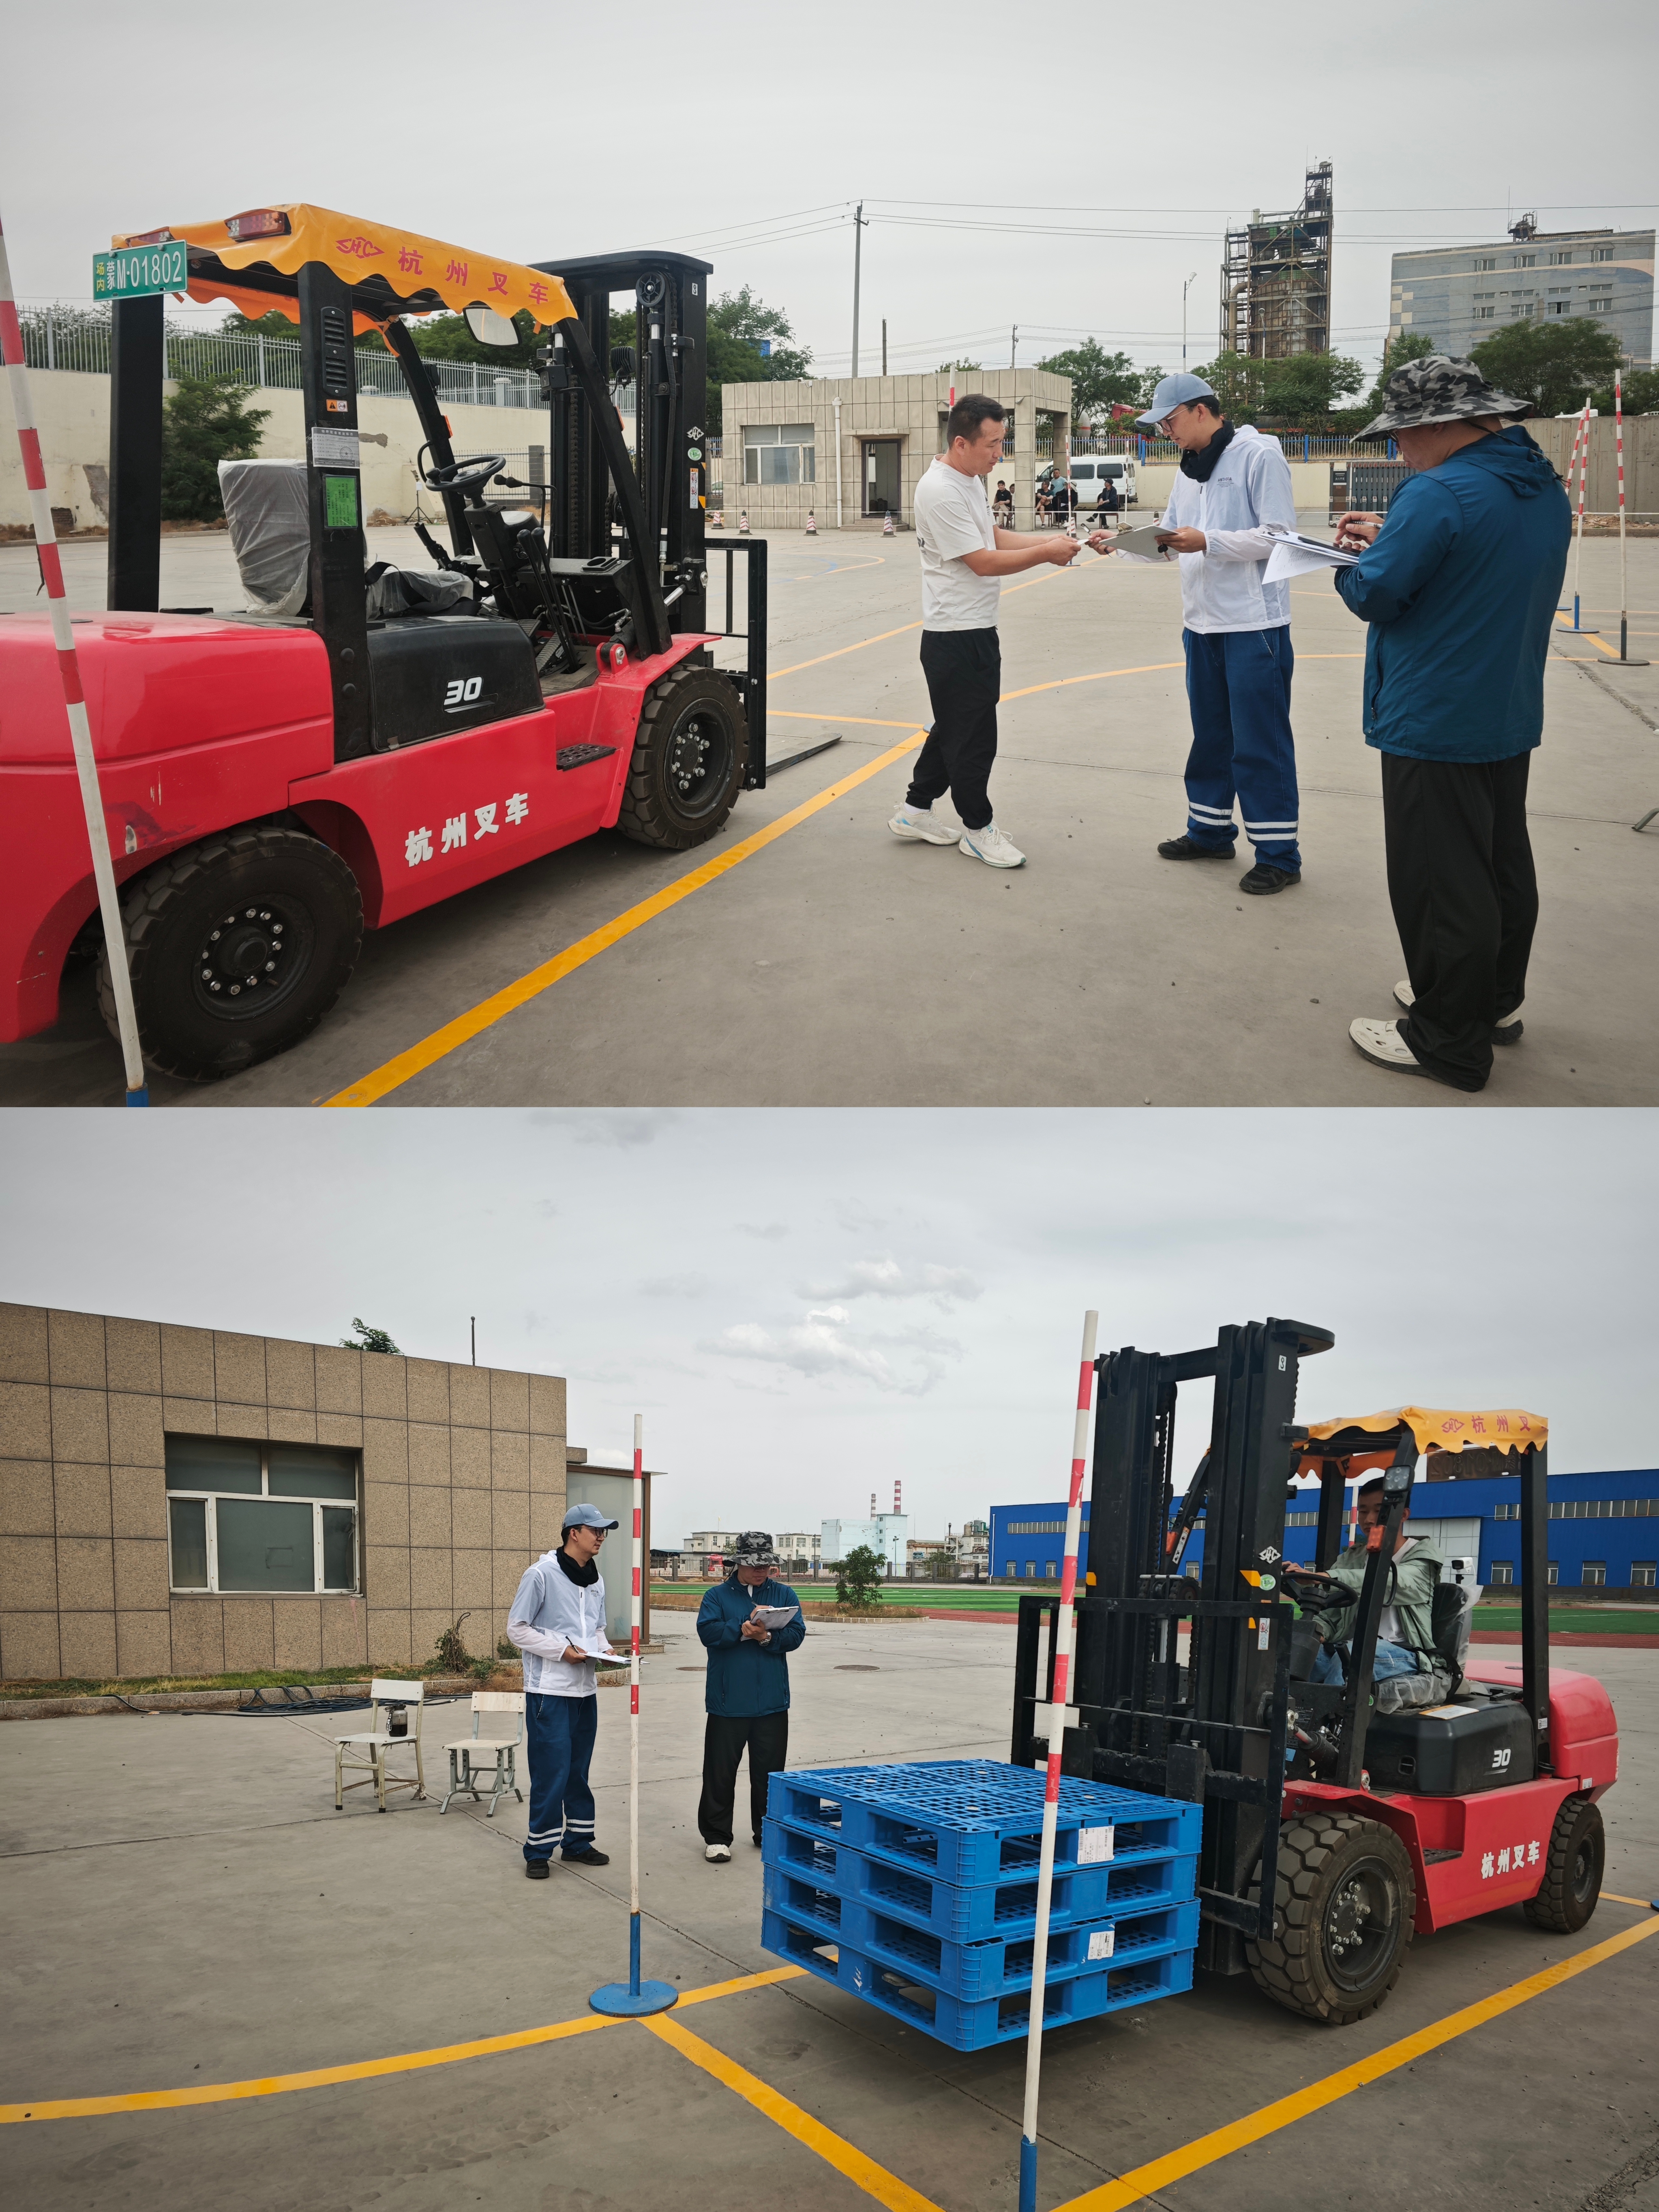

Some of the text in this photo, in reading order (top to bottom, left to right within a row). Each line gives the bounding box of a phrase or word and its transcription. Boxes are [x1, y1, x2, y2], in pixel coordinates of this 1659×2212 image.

[96, 262, 105, 292] 场内
[398, 246, 549, 304] 杭州叉车
[444, 677, 482, 705] 30
[405, 792, 529, 867] 杭州叉车
[1471, 1415, 1548, 1434] 杭州叉
[1492, 1748, 1511, 1768] 30
[1481, 1840, 1540, 1879] 杭州叉车
